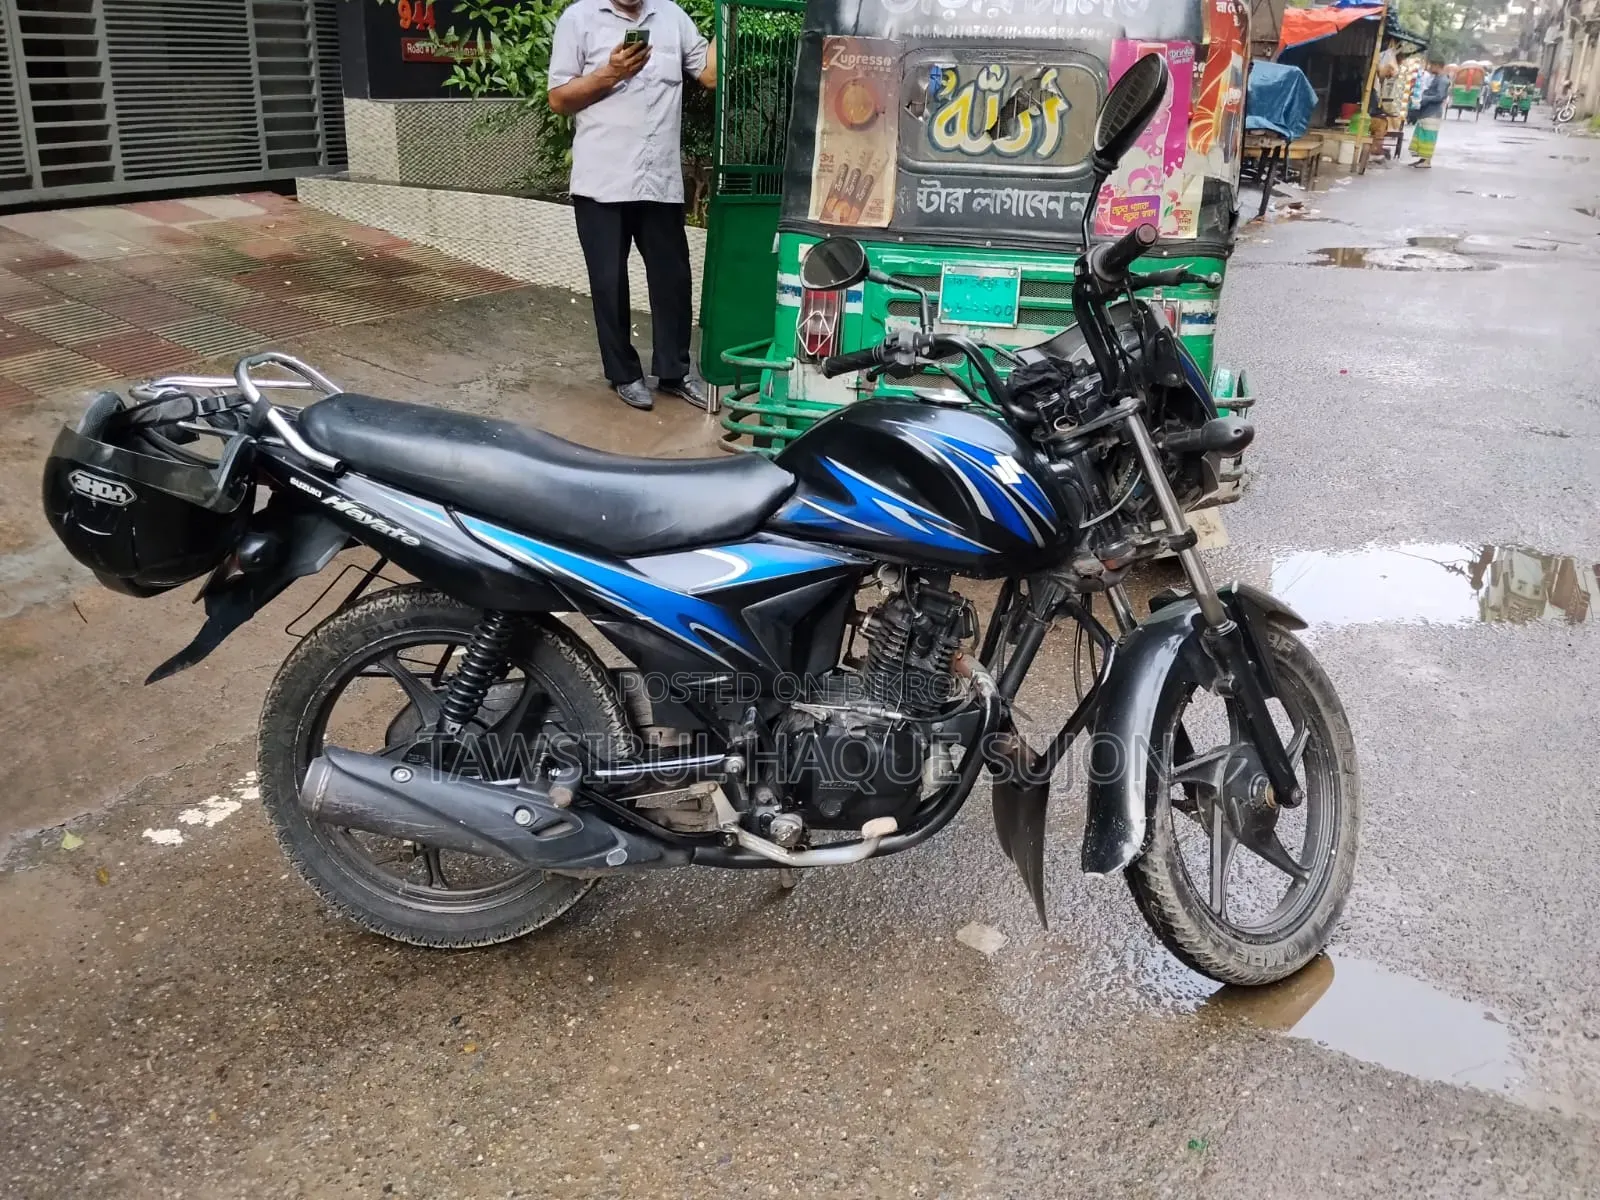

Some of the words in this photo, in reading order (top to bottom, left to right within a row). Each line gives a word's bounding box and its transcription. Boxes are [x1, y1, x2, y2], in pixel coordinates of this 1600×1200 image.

[830, 45, 892, 71] Zupresso
[972, 188, 1070, 219] লাগাবেন
[321, 495, 420, 546] Hayate
